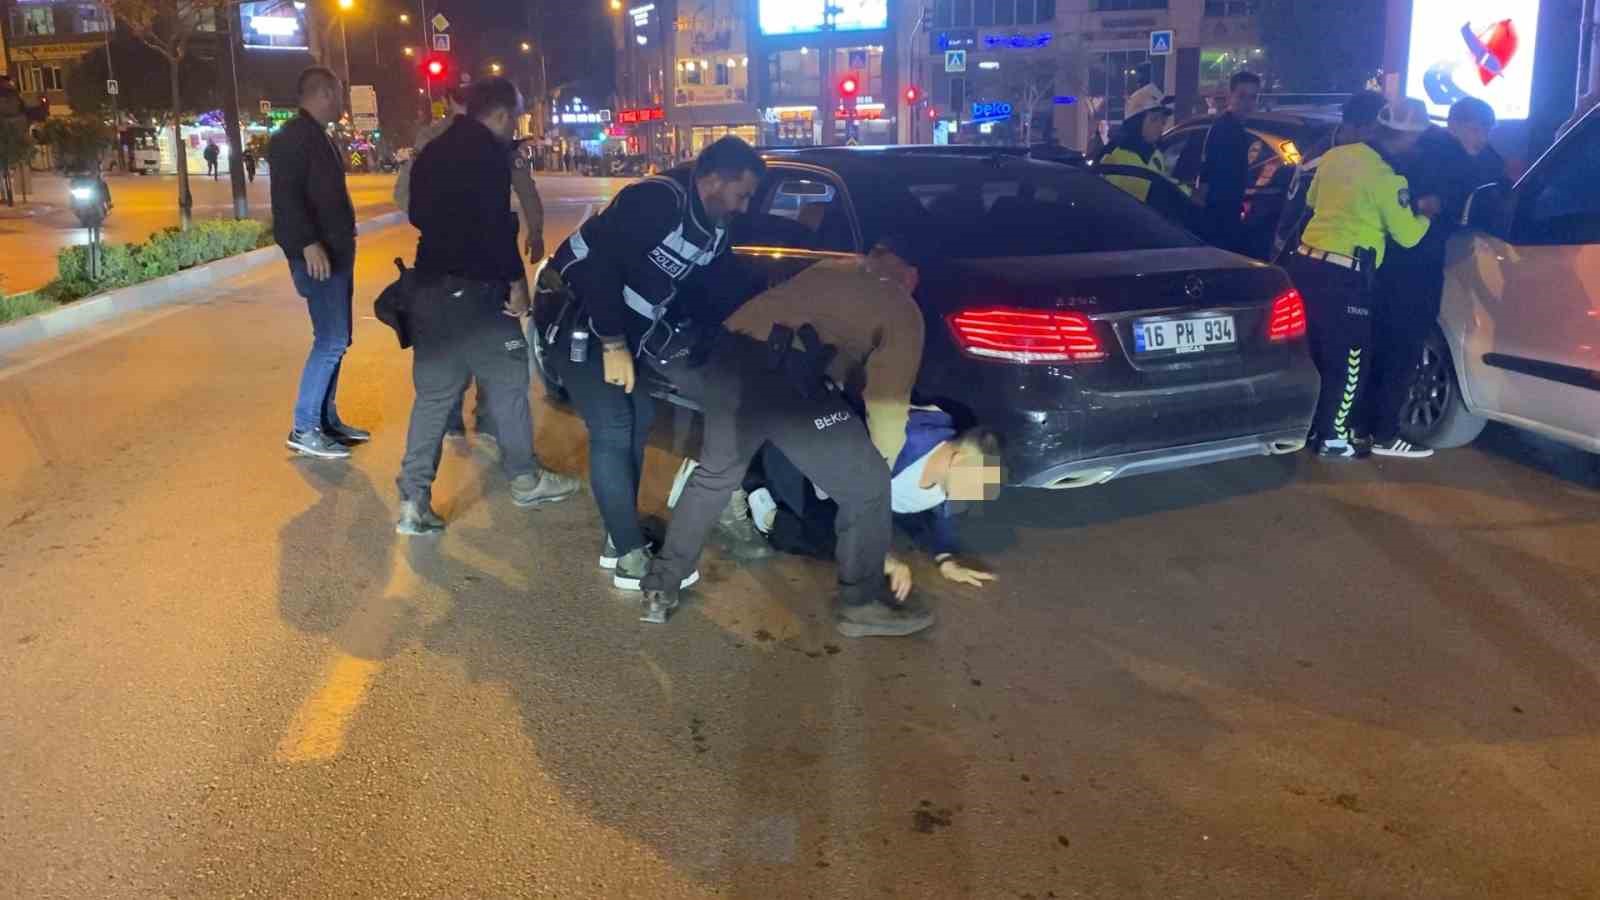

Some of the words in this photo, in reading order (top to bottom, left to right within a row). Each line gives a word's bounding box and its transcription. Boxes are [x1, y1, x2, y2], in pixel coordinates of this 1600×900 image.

[973, 101, 1010, 116] beko
[1144, 325, 1164, 348] 16
[1176, 322, 1195, 345] PH
[1204, 319, 1232, 342] 934
